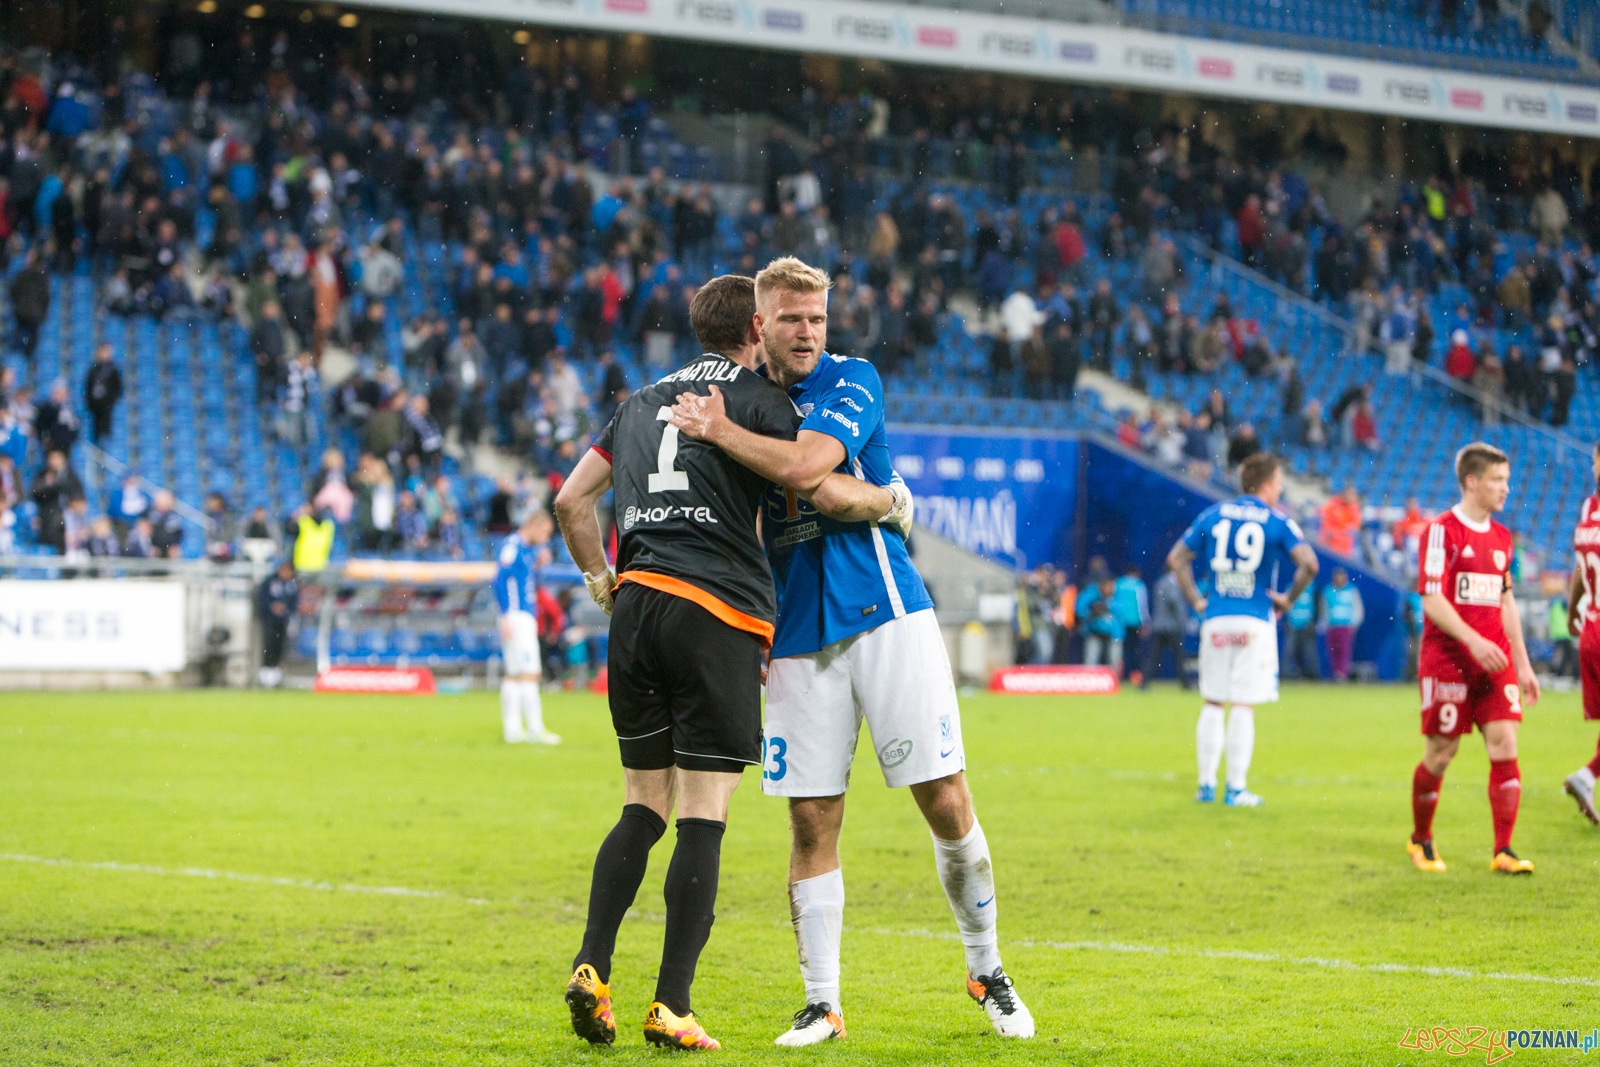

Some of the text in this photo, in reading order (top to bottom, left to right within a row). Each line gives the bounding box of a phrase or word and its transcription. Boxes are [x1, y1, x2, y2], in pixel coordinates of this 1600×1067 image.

[648, 405, 689, 494] 1
[1210, 518, 1265, 573] 19
[1439, 703, 1458, 733] 9
[884, 748, 905, 760] SGB
